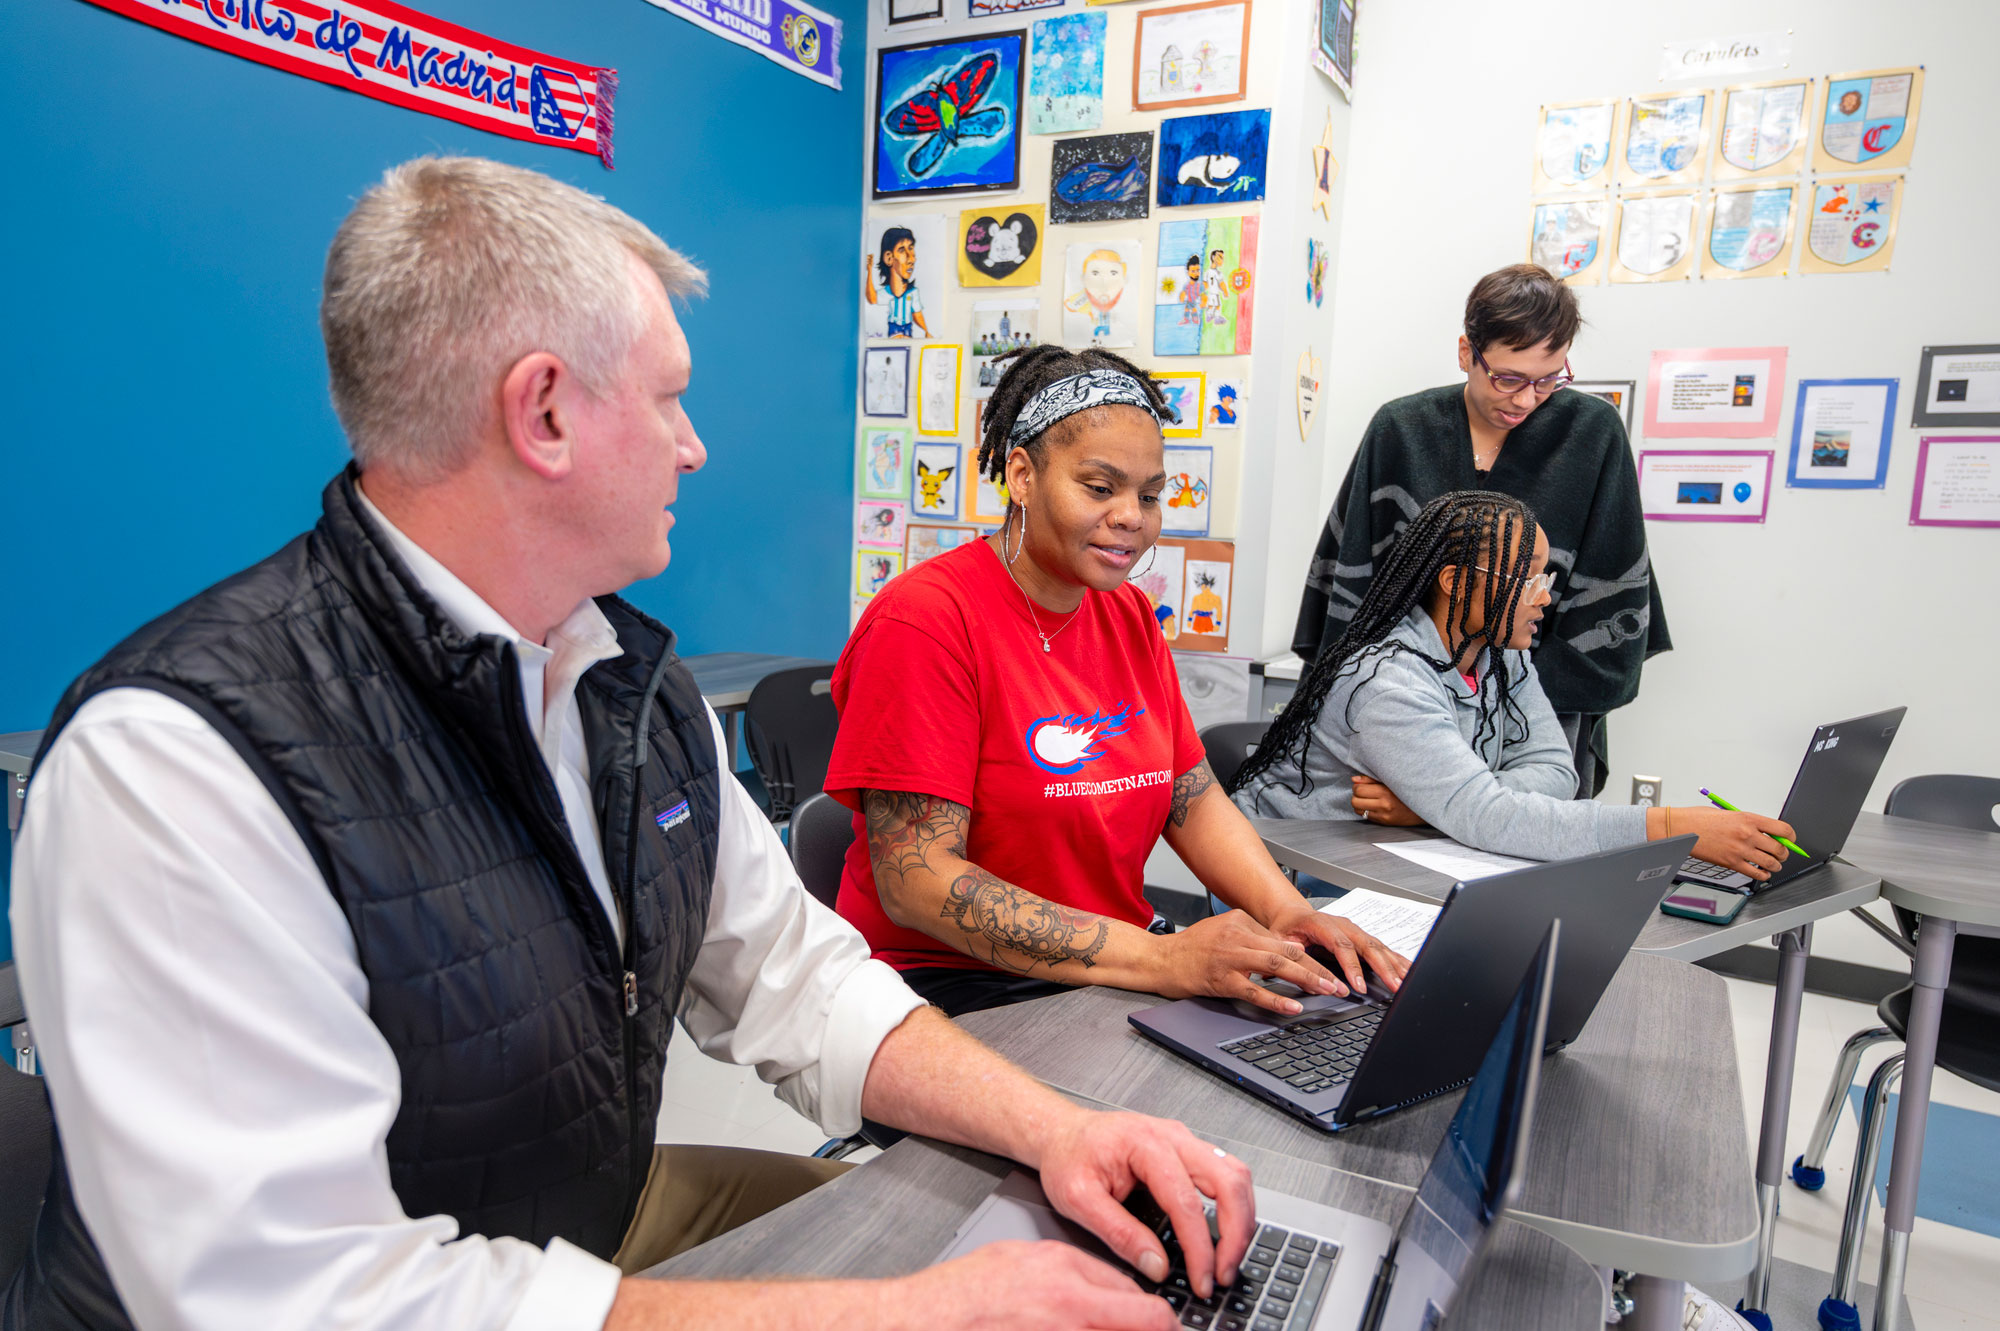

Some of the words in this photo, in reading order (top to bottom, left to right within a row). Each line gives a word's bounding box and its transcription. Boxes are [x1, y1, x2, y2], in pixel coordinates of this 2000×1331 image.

[714, 6, 771, 45] MUNDO
[315, 9, 362, 78] de
[377, 26, 519, 113] Madrid
[1862, 125, 1892, 153] C
[1852, 222, 1880, 249] C
[883, 370, 888, 382] 7
[1044, 770, 1171, 798] #BLUECOMETNATION
